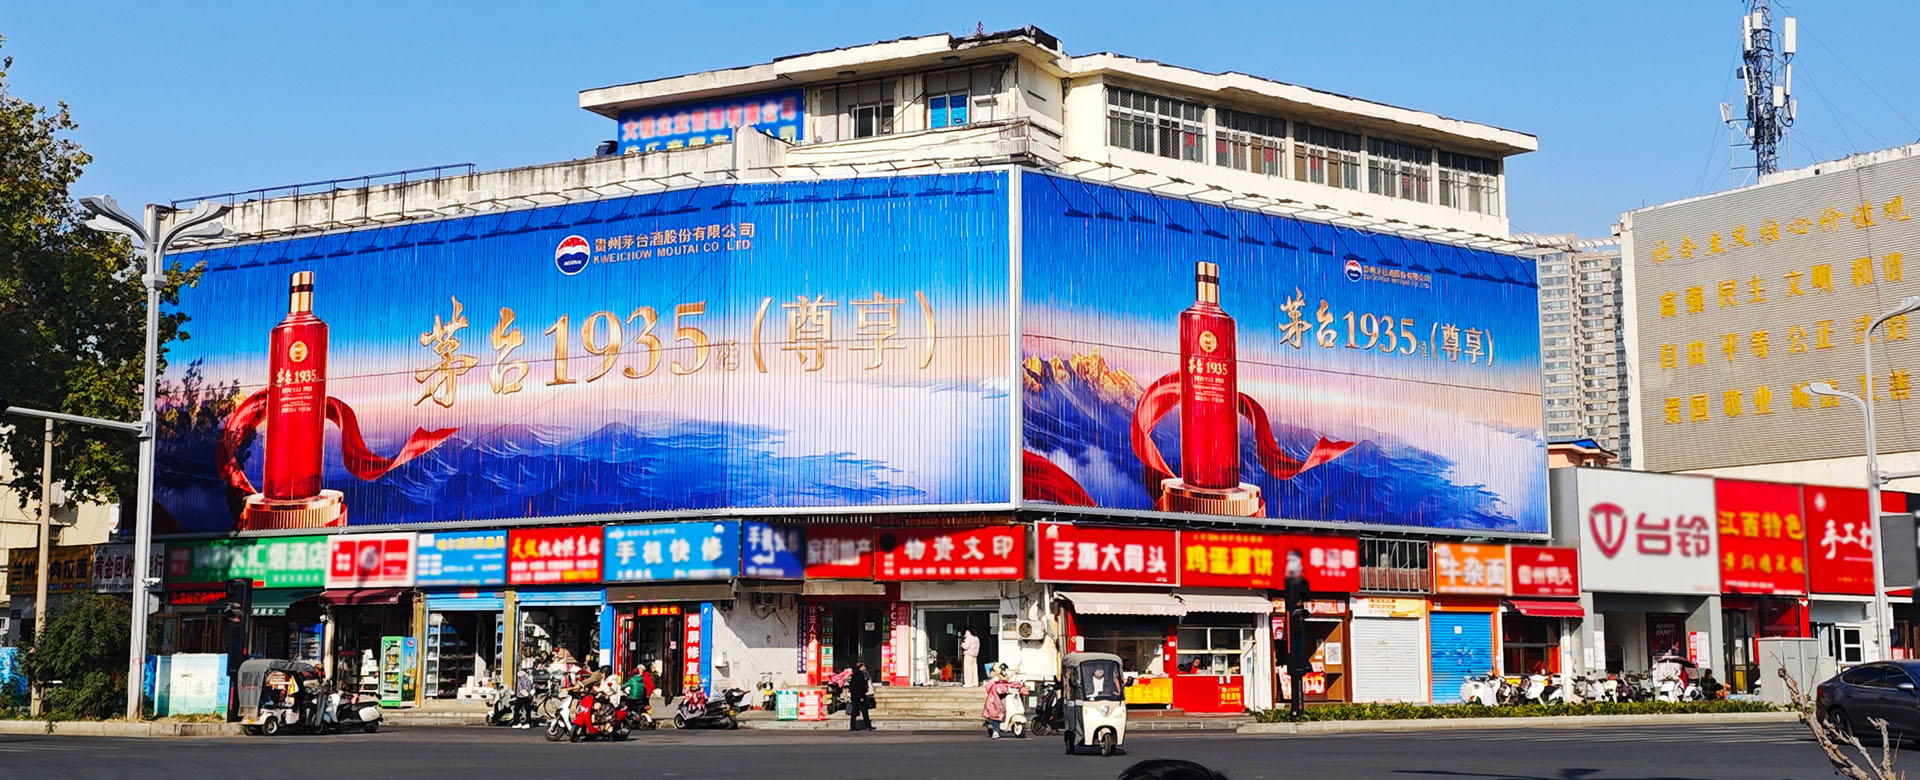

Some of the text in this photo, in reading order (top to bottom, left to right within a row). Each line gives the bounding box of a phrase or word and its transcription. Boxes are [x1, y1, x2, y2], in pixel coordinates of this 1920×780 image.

[594, 222, 755, 252] 贵州茅台酒股份有限公司
[1651, 195, 1911, 264] 社会主义核心价值观
[593, 251, 652, 265] KWEICHOW
[657, 245, 698, 258] MOUTAI
[1658, 251, 1904, 318] 富强 民主 文明 和谐
[1660, 338, 1706, 370] 自由
[1720, 329, 1769, 363] 平等
[1788, 319, 1835, 355] 公正
[1664, 393, 1709, 424] 爱国
[1723, 384, 1774, 418] 敬业
[1635, 512, 1711, 557] 台铃
[1719, 510, 1804, 541] 江西特色
[94, 553, 164, 580] 黄金回收行
[616, 536, 723, 565] 手机快修
[1186, 544, 1273, 577] 鸡蛋灌饼
[12, 558, 88, 582] 兰州肉拉面
[686, 614, 700, 675] 爆屏修复
